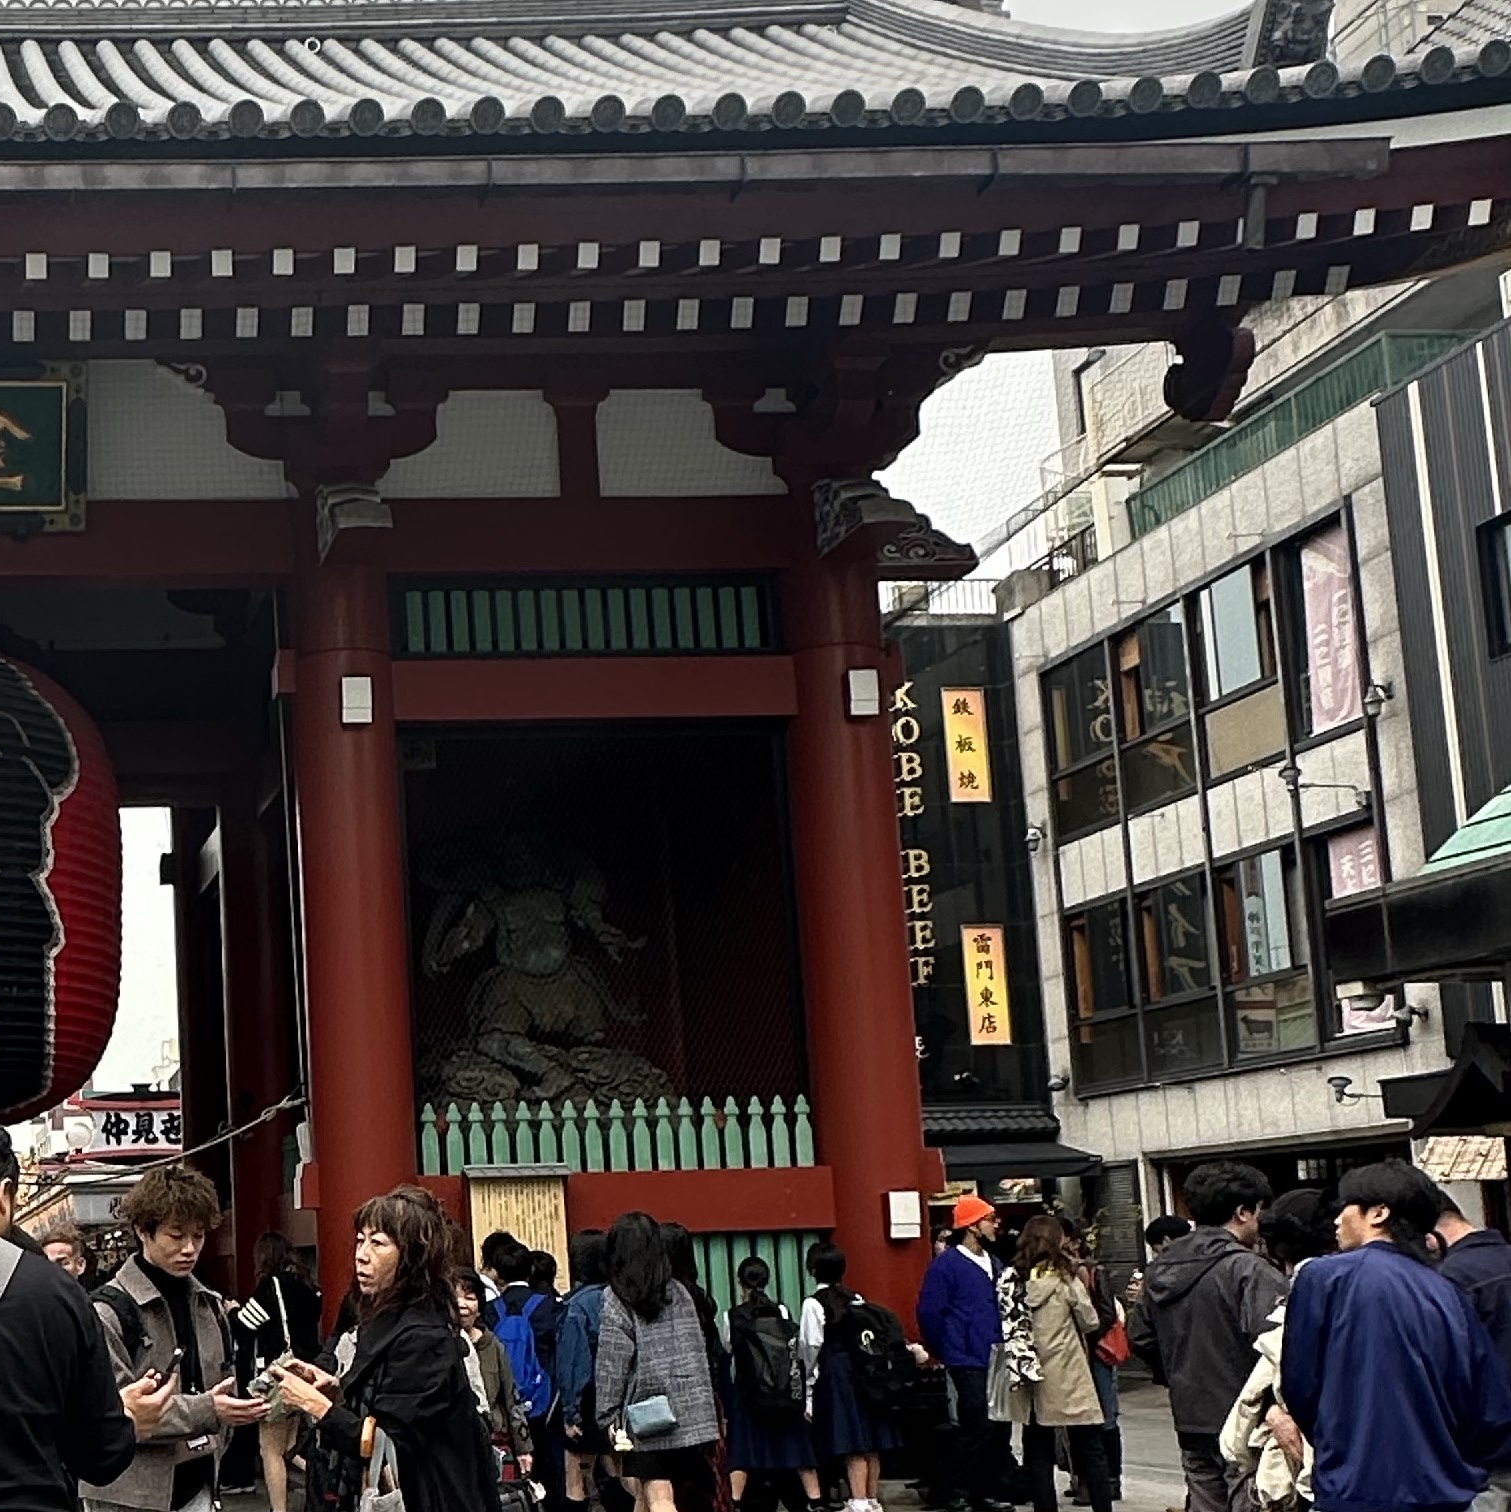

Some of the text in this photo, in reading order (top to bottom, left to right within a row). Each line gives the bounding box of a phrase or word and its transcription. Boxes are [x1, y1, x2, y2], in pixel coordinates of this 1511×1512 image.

[888, 681, 936, 987] KOBE BEEF
[972, 932, 999, 1034] 雷門東店
